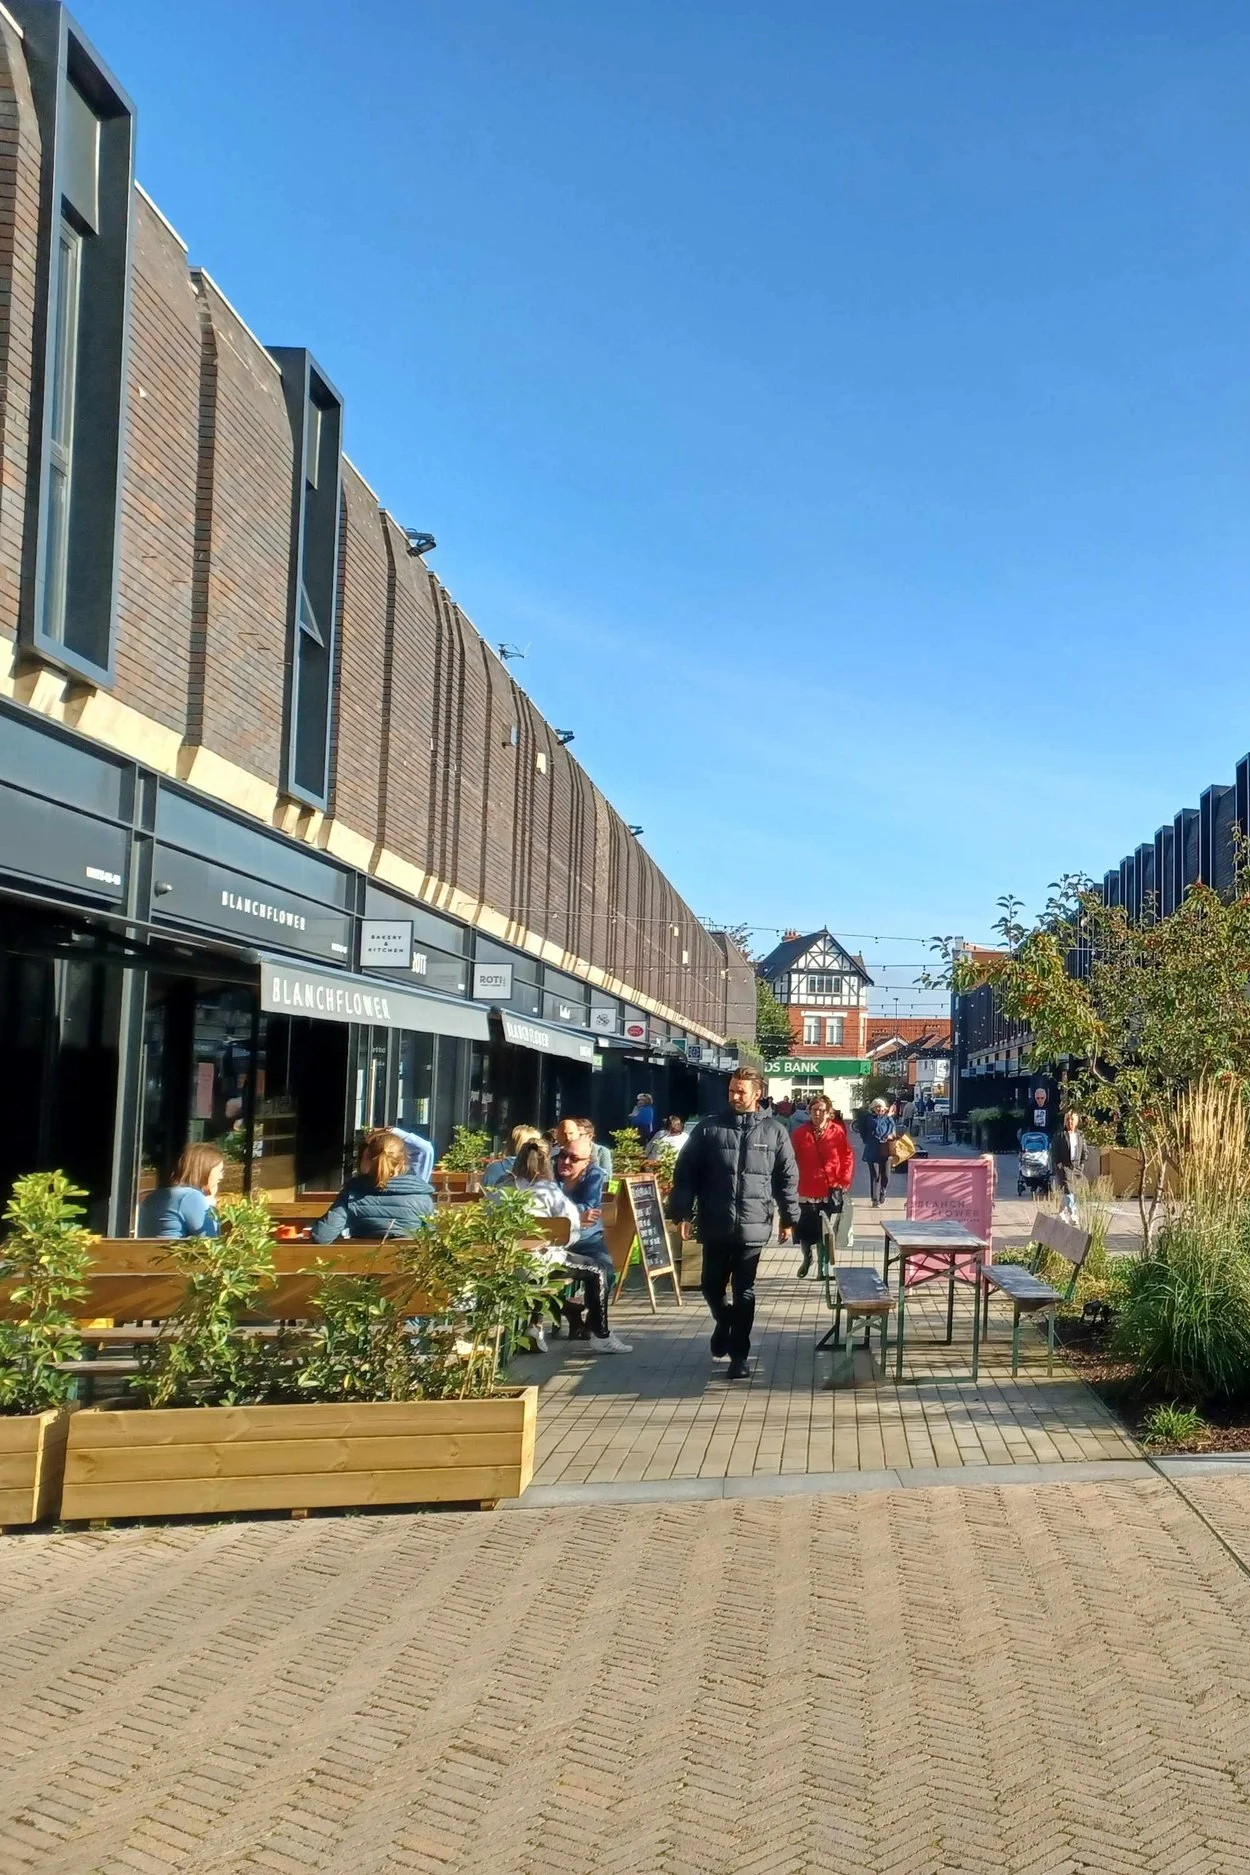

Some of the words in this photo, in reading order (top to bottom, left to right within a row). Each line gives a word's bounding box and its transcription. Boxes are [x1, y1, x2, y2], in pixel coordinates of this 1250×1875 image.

[221, 890, 306, 931] BLANCHFLOWER
[479, 975, 503, 984] ROTI
[272, 977, 391, 1020] BLANCHFLOWER
[784, 1062, 819, 1073] BANK
[917, 1200, 965, 1208] BLANCH
